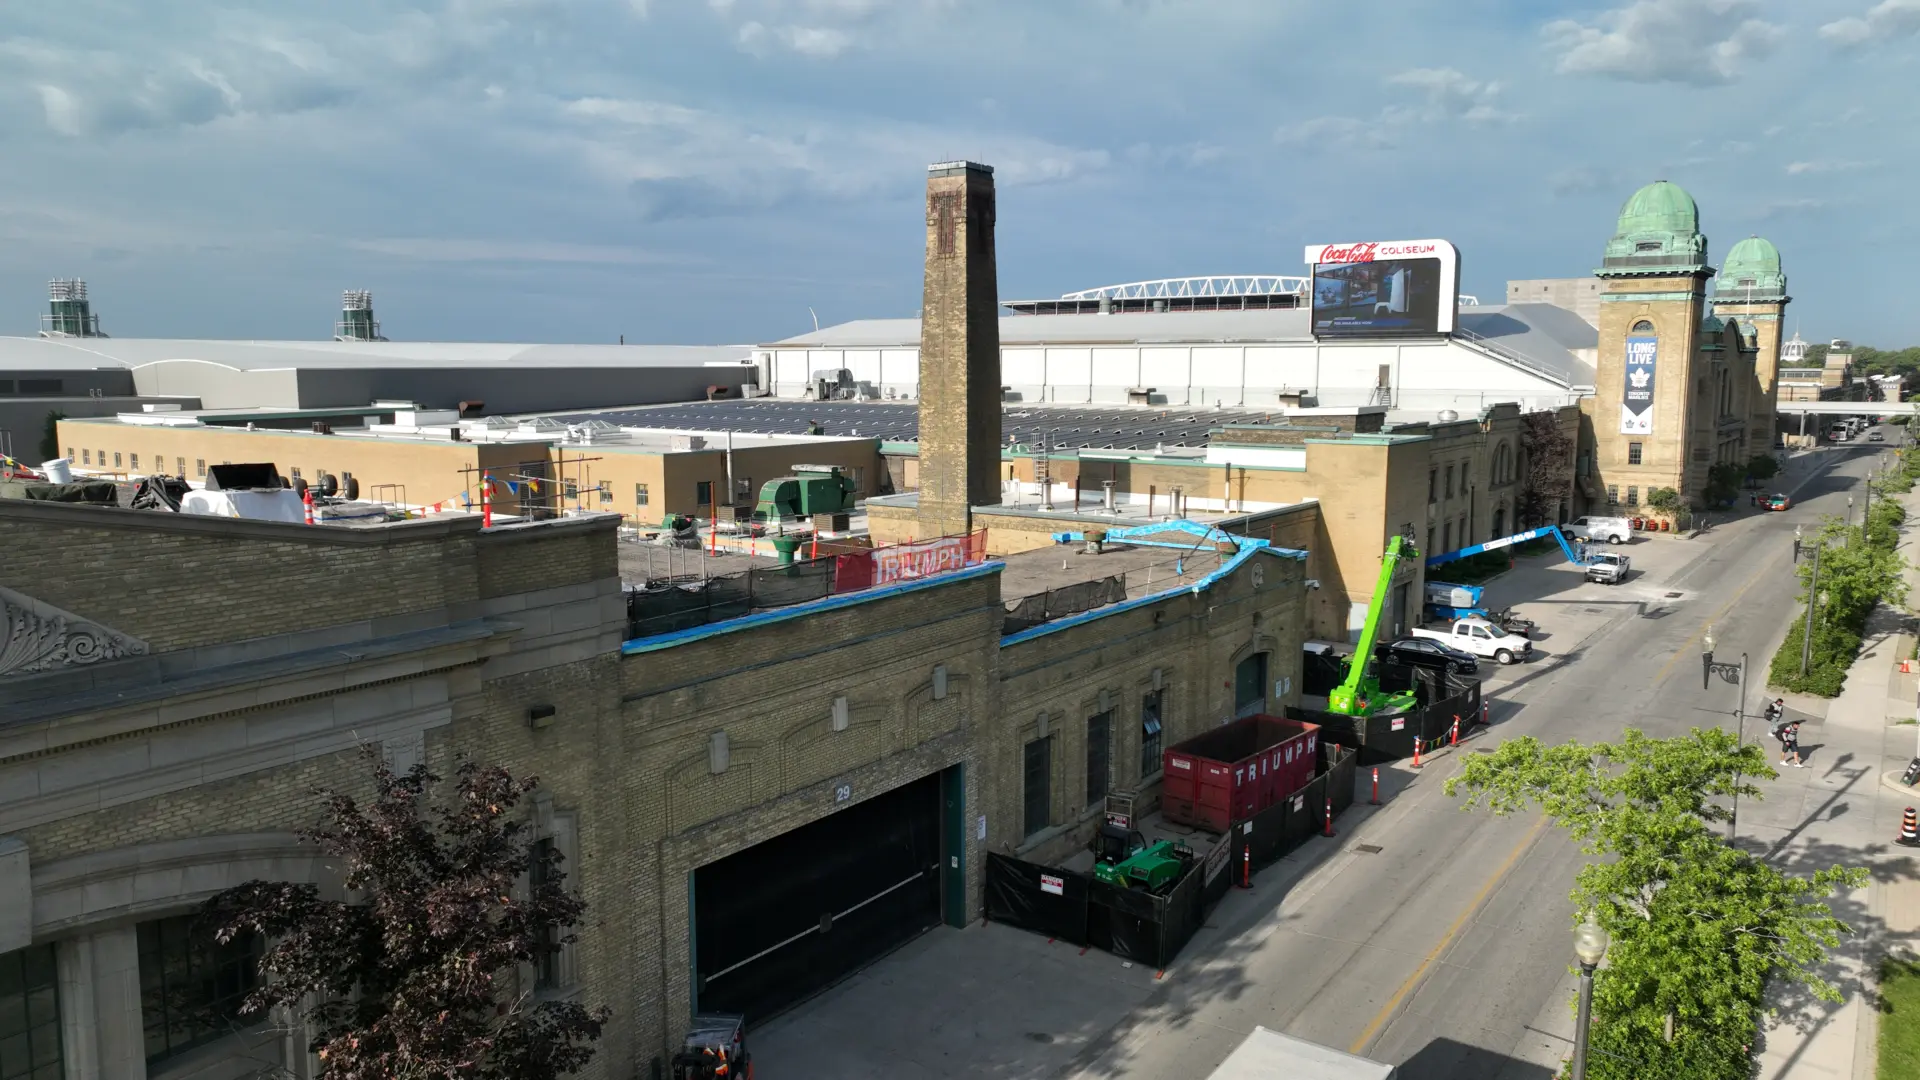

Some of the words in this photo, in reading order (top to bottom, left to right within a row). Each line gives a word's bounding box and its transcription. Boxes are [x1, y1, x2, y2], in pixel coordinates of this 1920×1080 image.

[1320, 243, 1379, 264] Coca-Cola
[1381, 245, 1435, 255] COLISEUM
[1628, 342, 1656, 354] LONG
[1629, 353, 1653, 365] LIVE
[871, 547, 964, 584] TRIUMPH
[1236, 736, 1316, 787] TRIUMPH
[837, 785, 850, 801] 29
